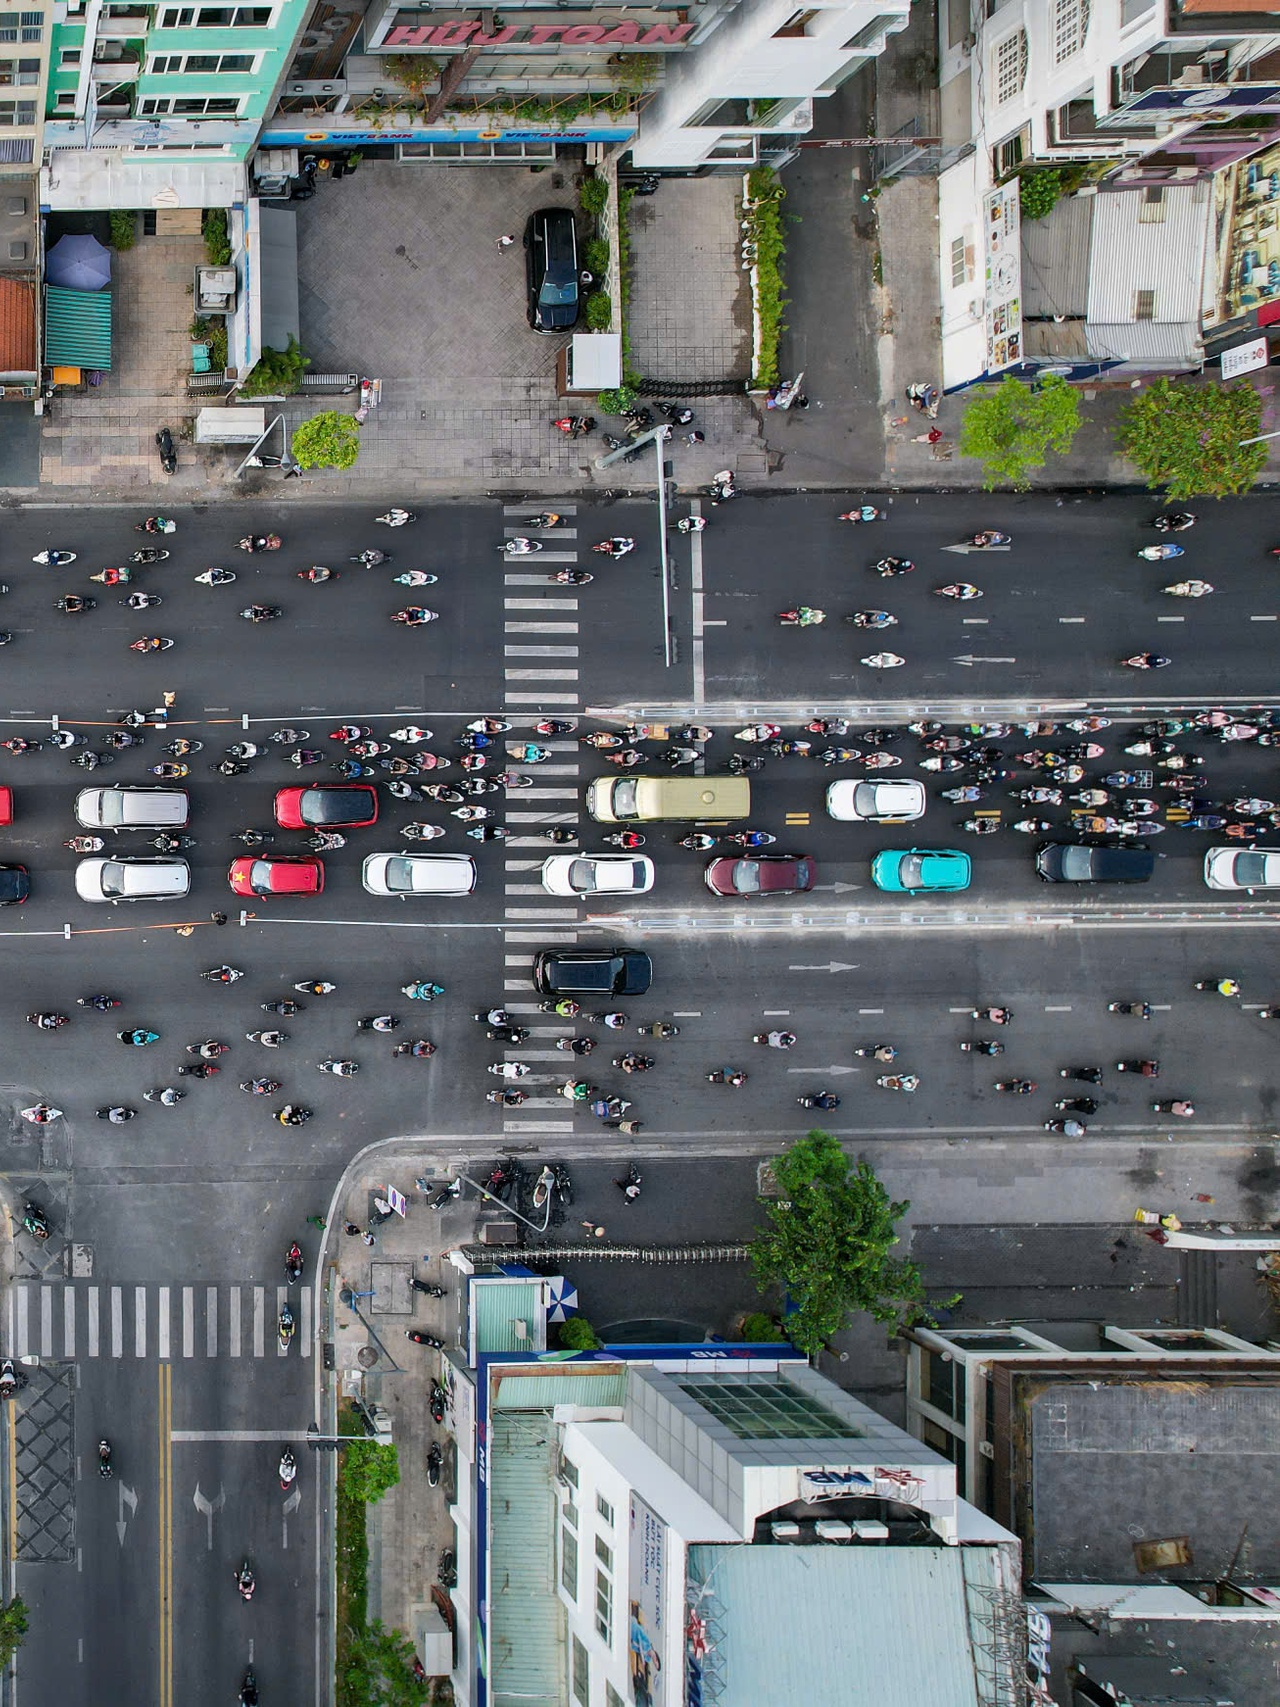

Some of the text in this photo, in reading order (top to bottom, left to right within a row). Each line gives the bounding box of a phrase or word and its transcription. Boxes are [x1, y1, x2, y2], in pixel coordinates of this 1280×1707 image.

[525, 20, 698, 46] TOÀN
[690, 1350, 728, 1359] MB
[479, 1446, 486, 1483] MB
[802, 1471, 872, 1487] MB
